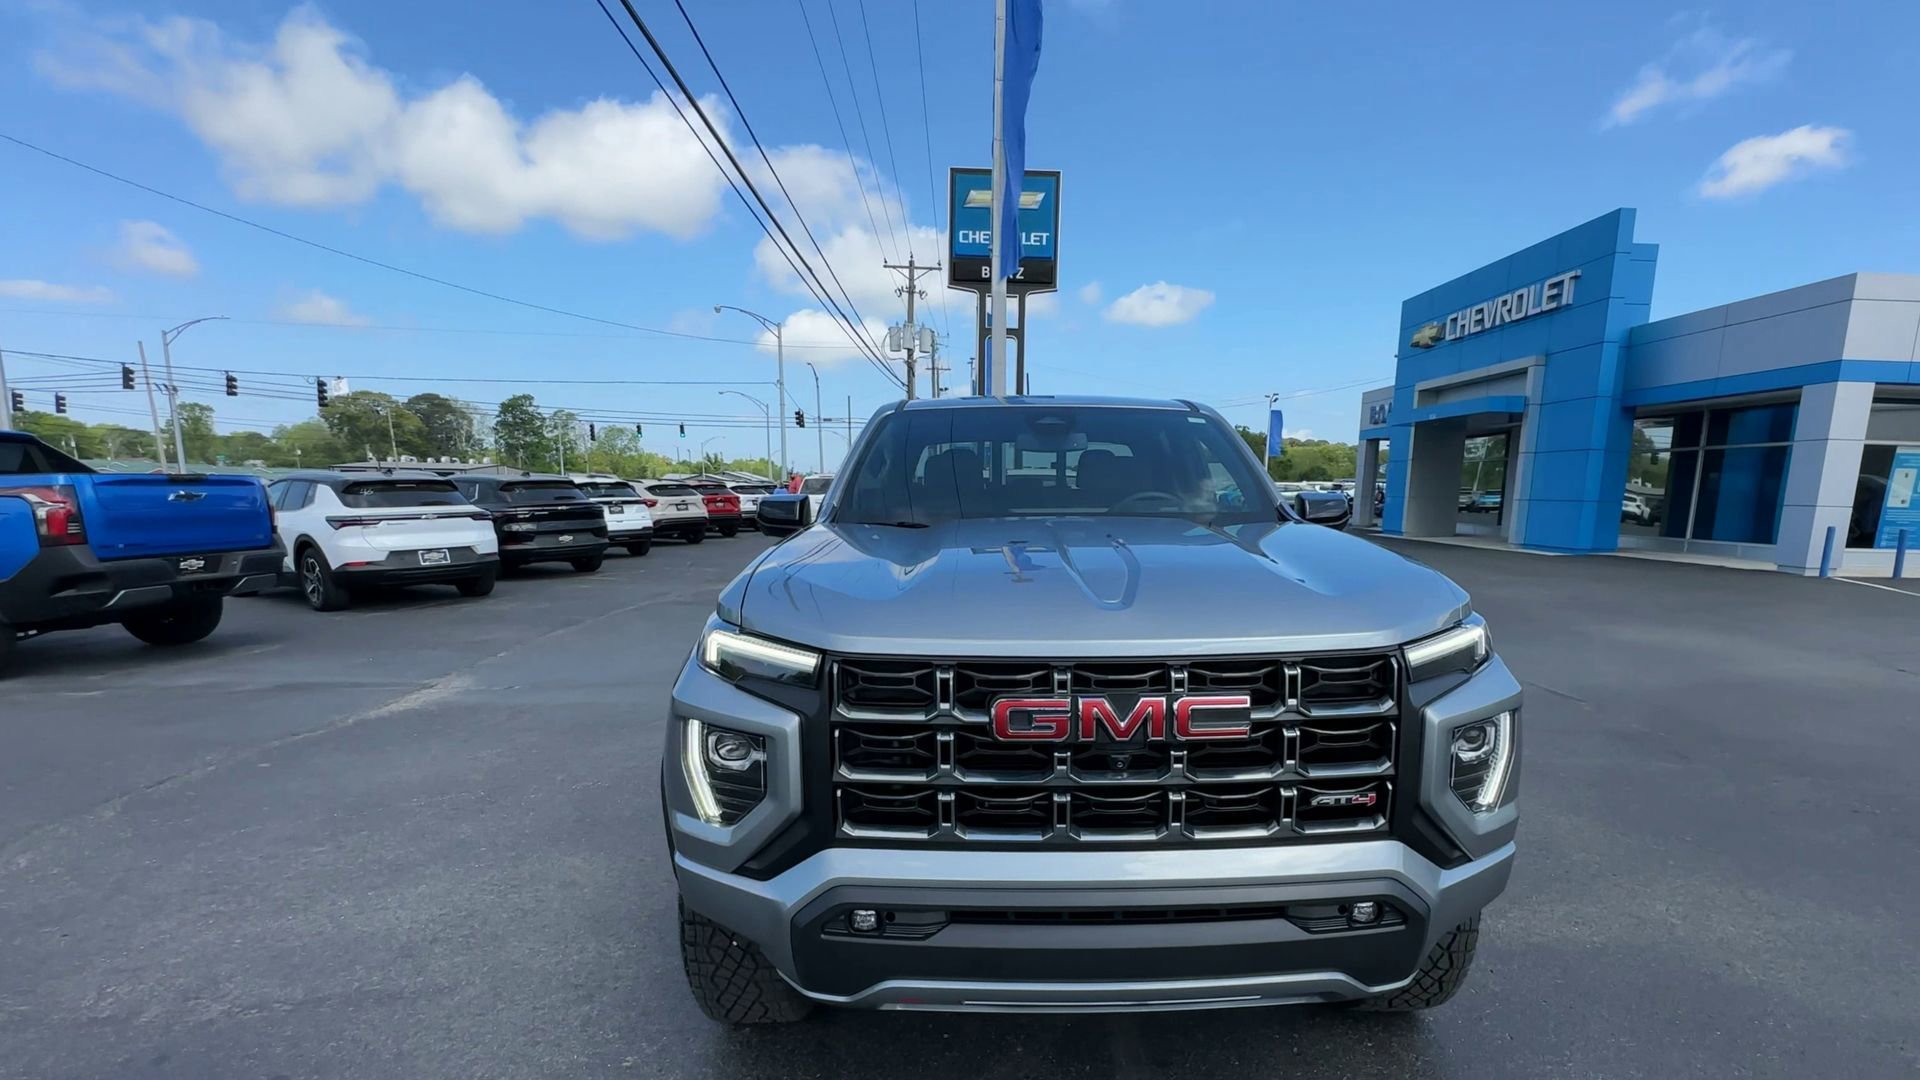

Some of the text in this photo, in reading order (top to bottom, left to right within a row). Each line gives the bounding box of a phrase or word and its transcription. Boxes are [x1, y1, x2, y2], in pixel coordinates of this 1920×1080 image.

[959, 230, 1049, 245] CHELET
[981, 266, 1024, 279] BZ
[1445, 270, 1581, 341] CHEVROLET
[992, 695, 1250, 741] GMC
[1311, 793, 1376, 806] AT4
